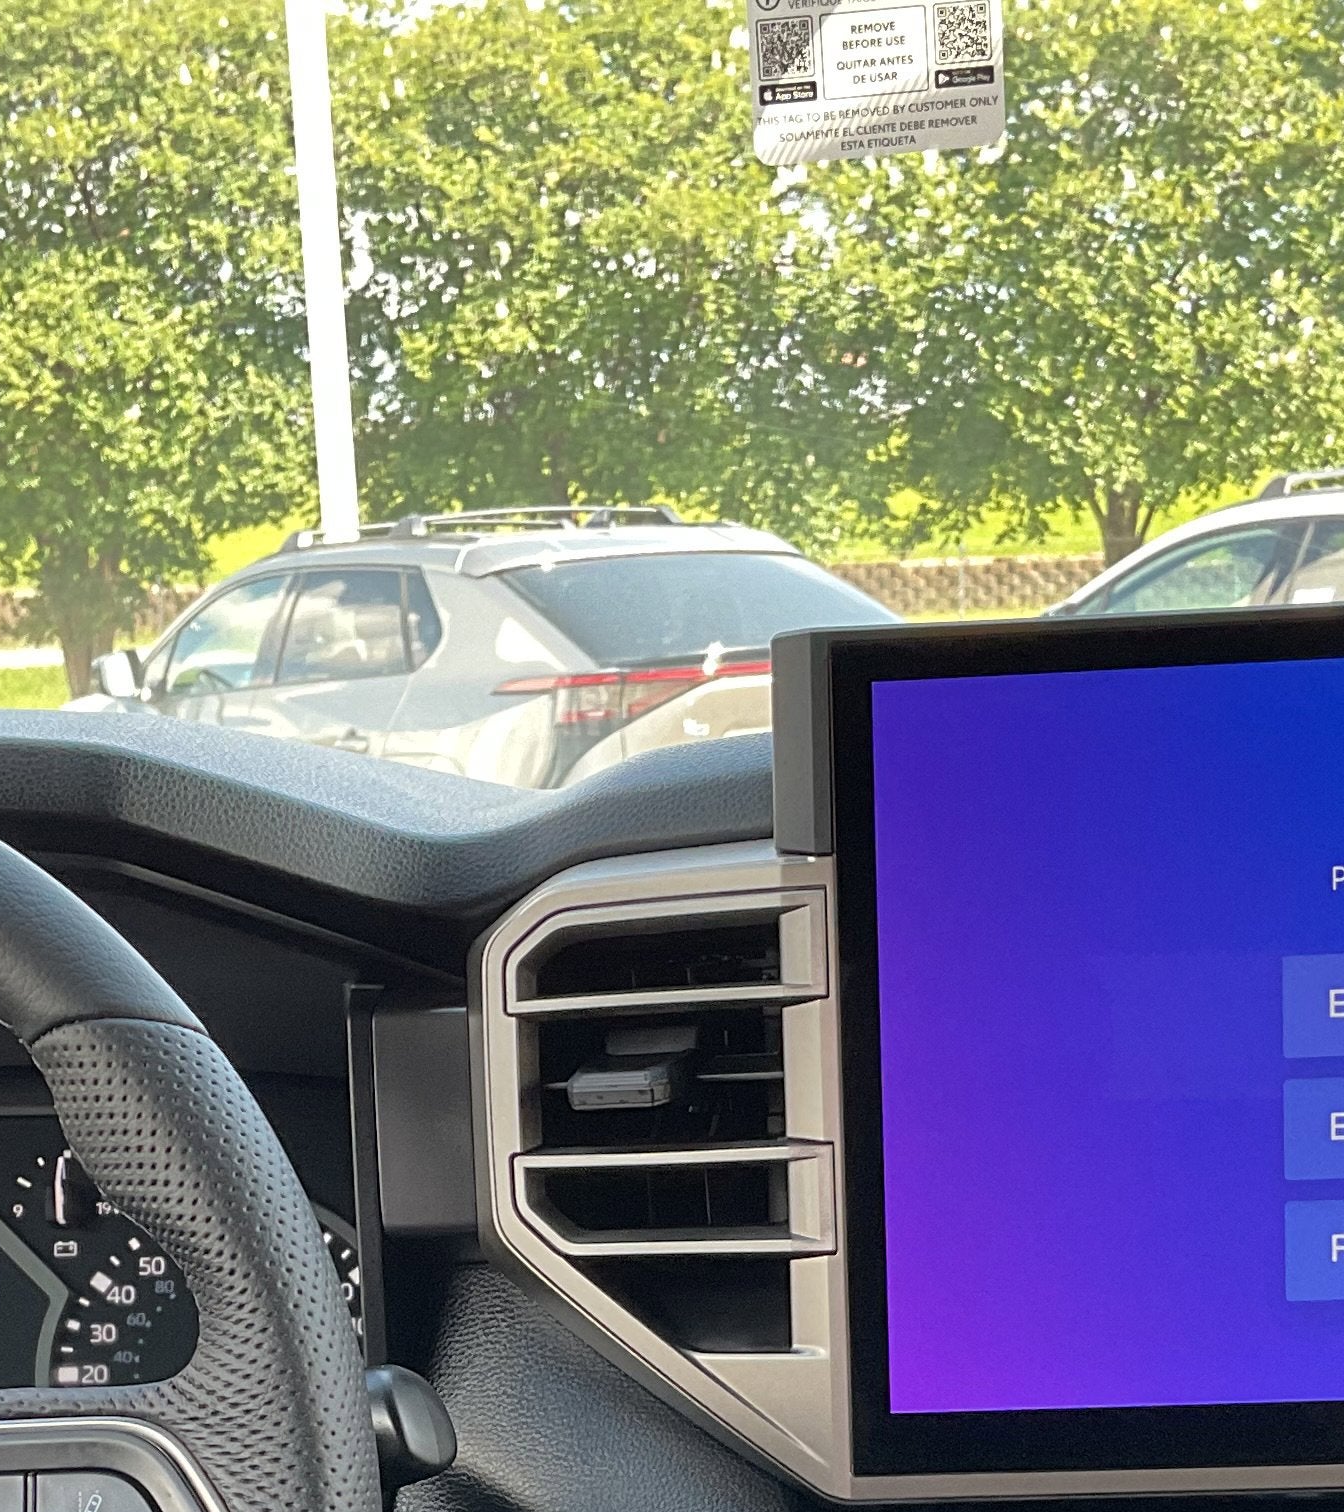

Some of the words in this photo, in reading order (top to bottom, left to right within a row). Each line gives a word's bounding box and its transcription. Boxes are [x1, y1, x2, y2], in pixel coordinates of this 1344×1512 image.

[850, 21, 896, 35] REMOVE
[842, 36, 882, 50] BEFORE
[884, 35, 906, 47] USE
[836, 57, 877, 71] QUITAR
[878, 54, 914, 67] ANTES
[853, 73, 867, 85] DE
[868, 71, 898, 83] USAR
[758, 115, 780, 127] THIS
[782, 113, 804, 125] TAG
[806, 111, 821, 123] TO
[823, 109, 836, 122] BE
[838, 106, 890, 121] REMOVED
[893, 103, 906, 116] BY
[908, 98, 966, 114] CUSTOMER
[968, 95, 999, 108] ONLY
[779, 129, 840, 143] SOLAMENTE
[842, 127, 855, 137] EL
[857, 123, 897, 137] CLIENTE
[899, 120, 926, 131] DEBE
[928, 115, 978, 129] REMOVER
[840, 139, 867, 151] ESTA
[868, 135, 917, 149] ETIQUETA
[12, 1204, 24, 1218] 9
[95, 1202, 112, 1215] 19
[138, 1255, 166, 1276] 50
[106, 1284, 136, 1305] 40
[126, 1312, 146, 1327] 60
[89, 1323, 117, 1344] 30
[113, 1350, 133, 1364] 40
[81, 1364, 109, 1384] 20
